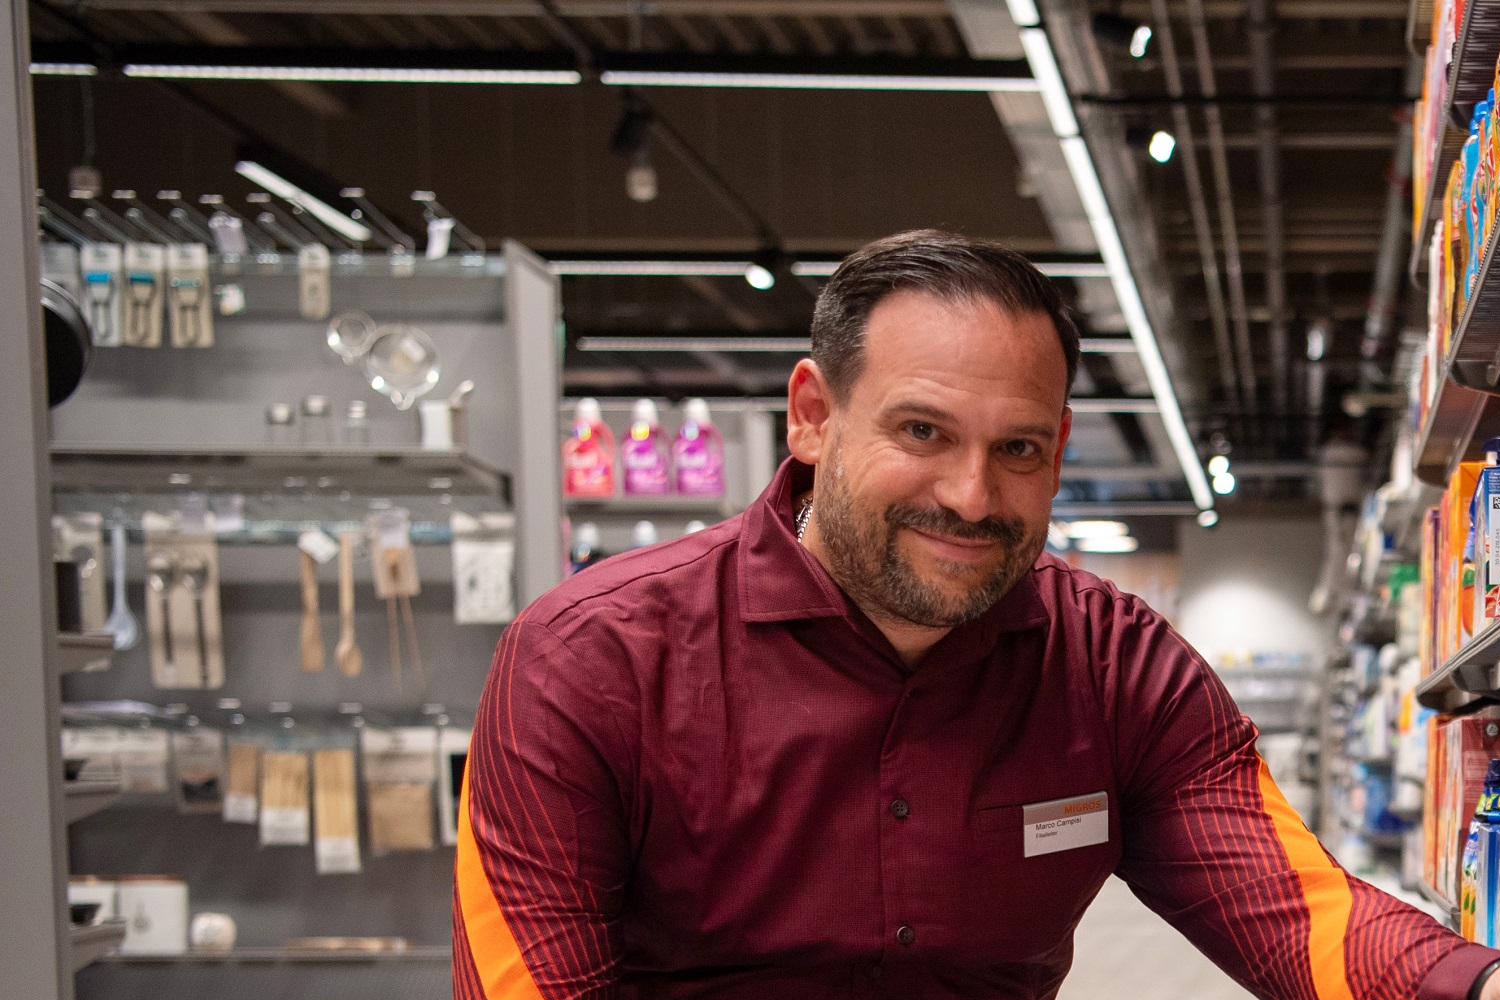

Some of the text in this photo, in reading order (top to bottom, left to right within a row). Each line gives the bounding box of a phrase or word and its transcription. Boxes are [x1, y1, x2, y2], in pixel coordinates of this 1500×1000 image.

[1064, 800, 1102, 814] MIGROS
[1035, 817, 1082, 831] Marco Campisi
